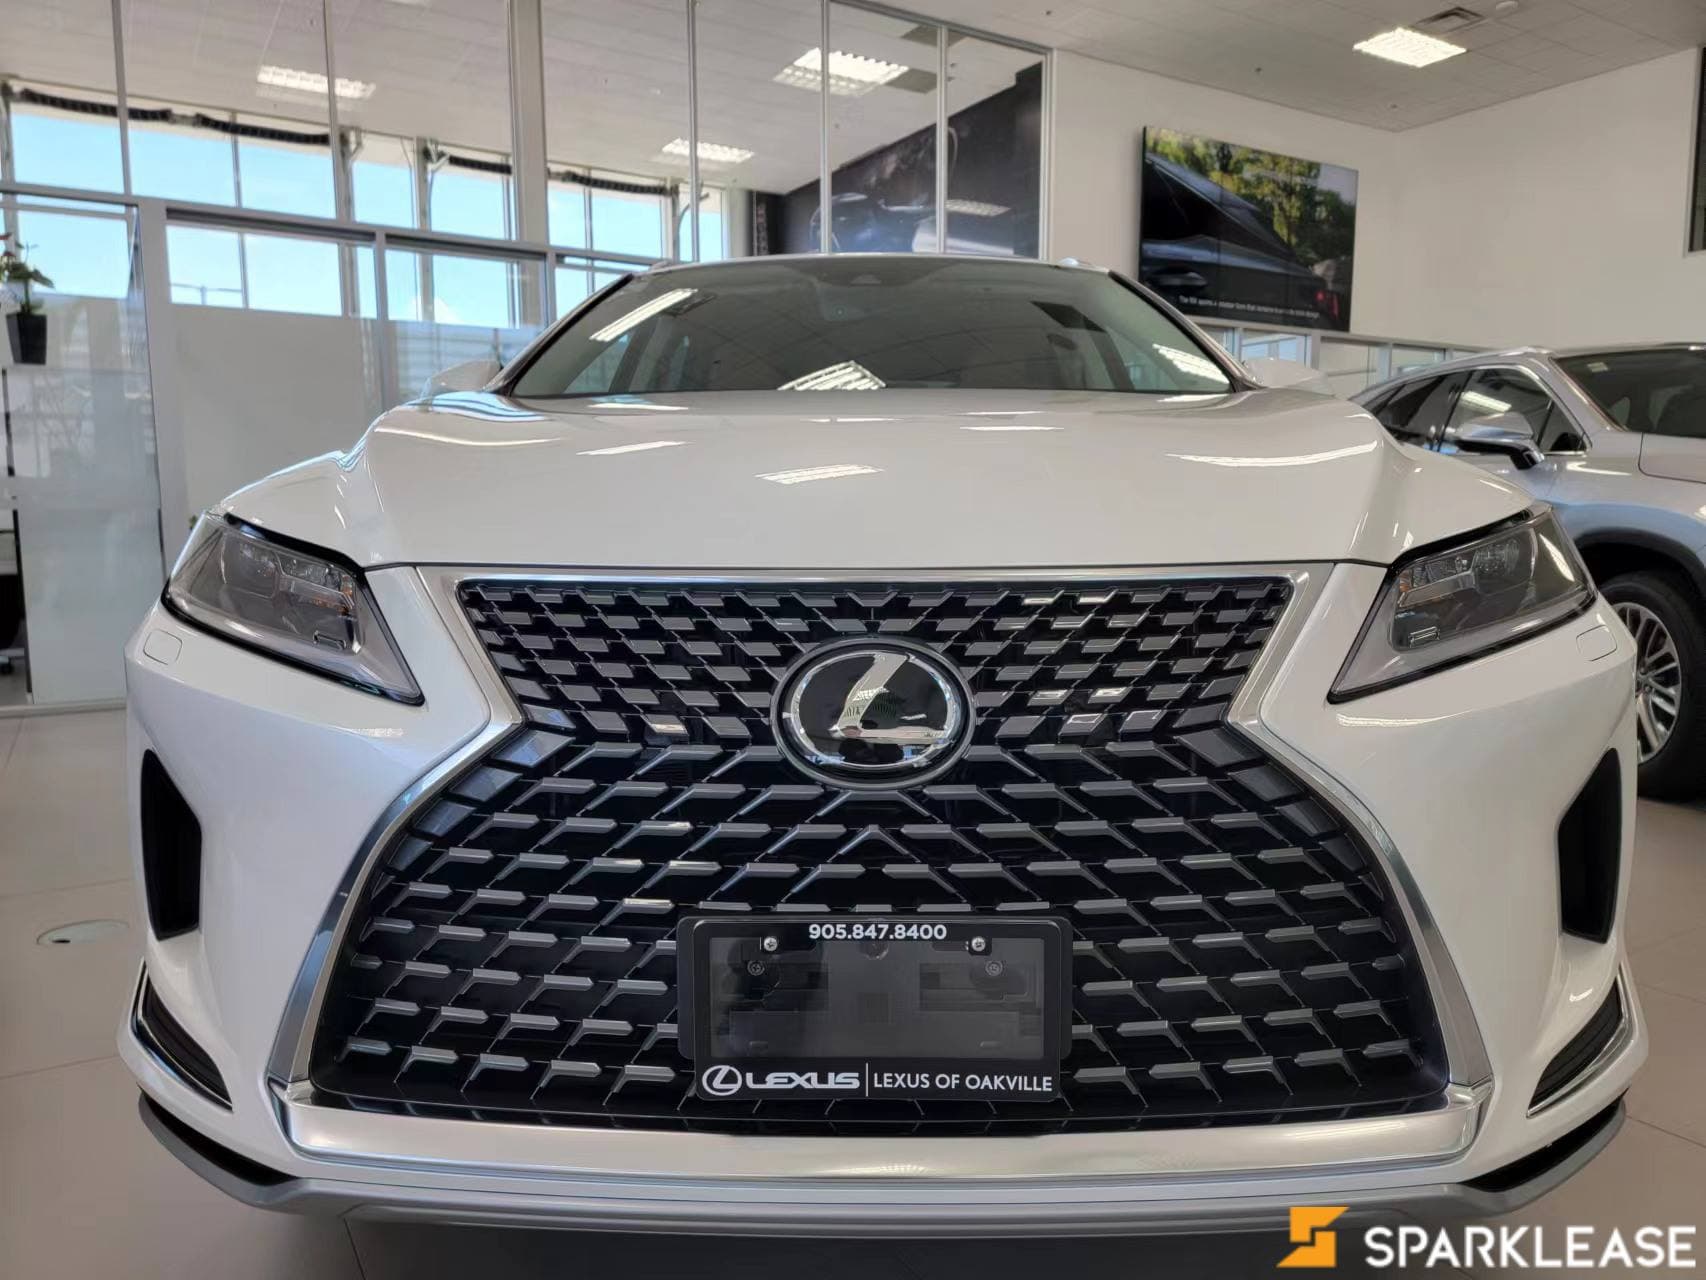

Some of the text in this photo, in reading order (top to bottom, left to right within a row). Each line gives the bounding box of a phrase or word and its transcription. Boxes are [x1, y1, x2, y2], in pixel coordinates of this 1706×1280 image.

[808, 924, 947, 940] 905.847.8400
[745, 1071, 861, 1089] LEXUS
[873, 1072, 1053, 1092] LEXUS OF OAKVILLE
